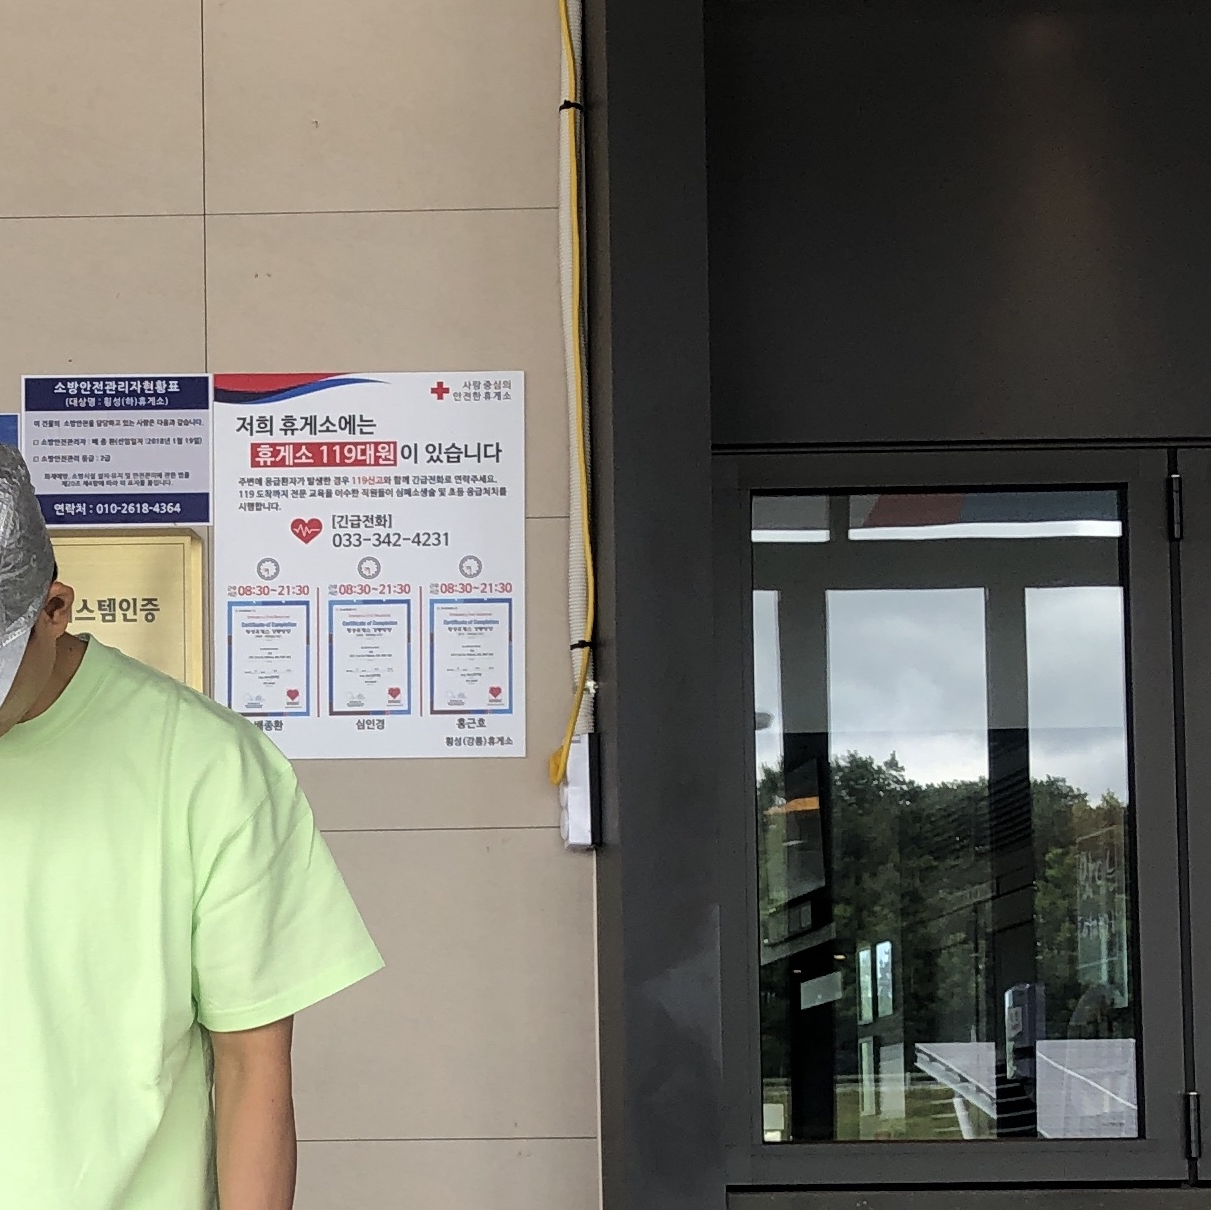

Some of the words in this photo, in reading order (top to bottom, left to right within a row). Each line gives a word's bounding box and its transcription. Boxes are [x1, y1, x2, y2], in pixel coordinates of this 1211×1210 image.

[53, 380, 180, 395] 소방안전관리자현황표
[462, 380, 481, 391] 사랑
[483, 380, 512, 390] 중심의
[453, 391, 481, 401] 안전한
[483, 391, 512, 400] 휴게소
[235, 415, 274, 436] 저희
[279, 414, 377, 435] 휴게소에는
[254, 445, 315, 466] 휴게소
[320, 444, 396, 465] 119대원
[400, 442, 418, 464] 이
[424, 442, 502, 463] 있습니다
[238, 490, 254, 499] 119
[256, 490, 288, 498] 도착까지
[53, 503, 87, 516] 연락처
[95, 502, 181, 514] 010-2618-4364
[238, 502, 282, 512] 시행합니다.
[331, 514, 392, 529] [긴급전화]
[331, 531, 450, 548] 033-342-4231
[238, 585, 310, 596] 08:30~21:30
[339, 584, 411, 595] 08:30~21:30
[440, 582, 512, 594] 08:30~21:30
[356, 719, 386, 730] 심인경
